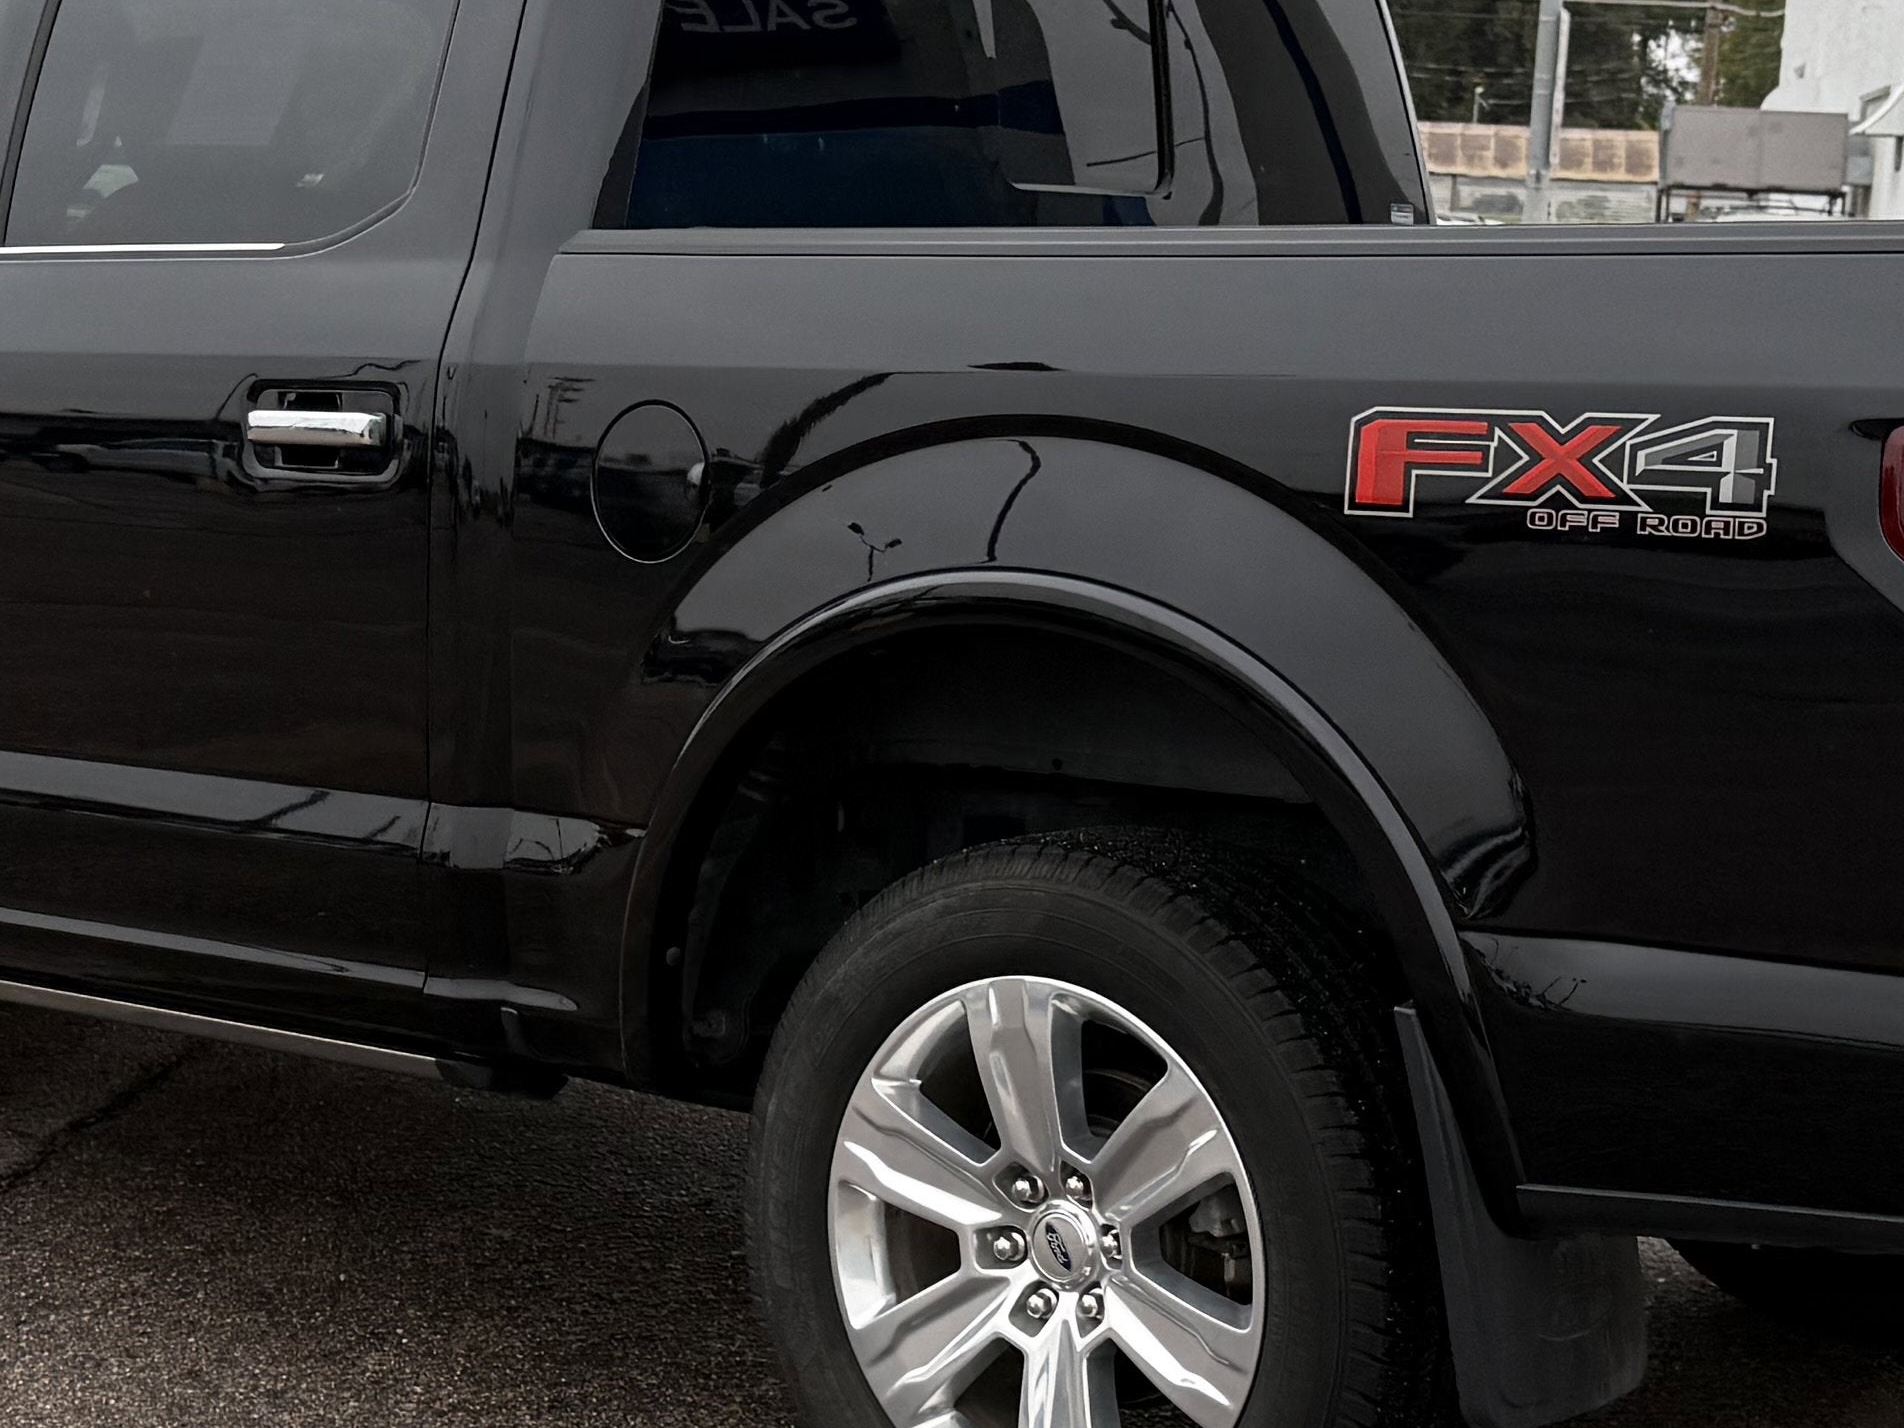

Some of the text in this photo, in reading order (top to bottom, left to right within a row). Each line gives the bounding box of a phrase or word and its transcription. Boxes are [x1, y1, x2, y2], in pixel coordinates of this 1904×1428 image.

[1344, 406, 1777, 518] FX4
[1527, 509, 1767, 540] OFF ROAD
